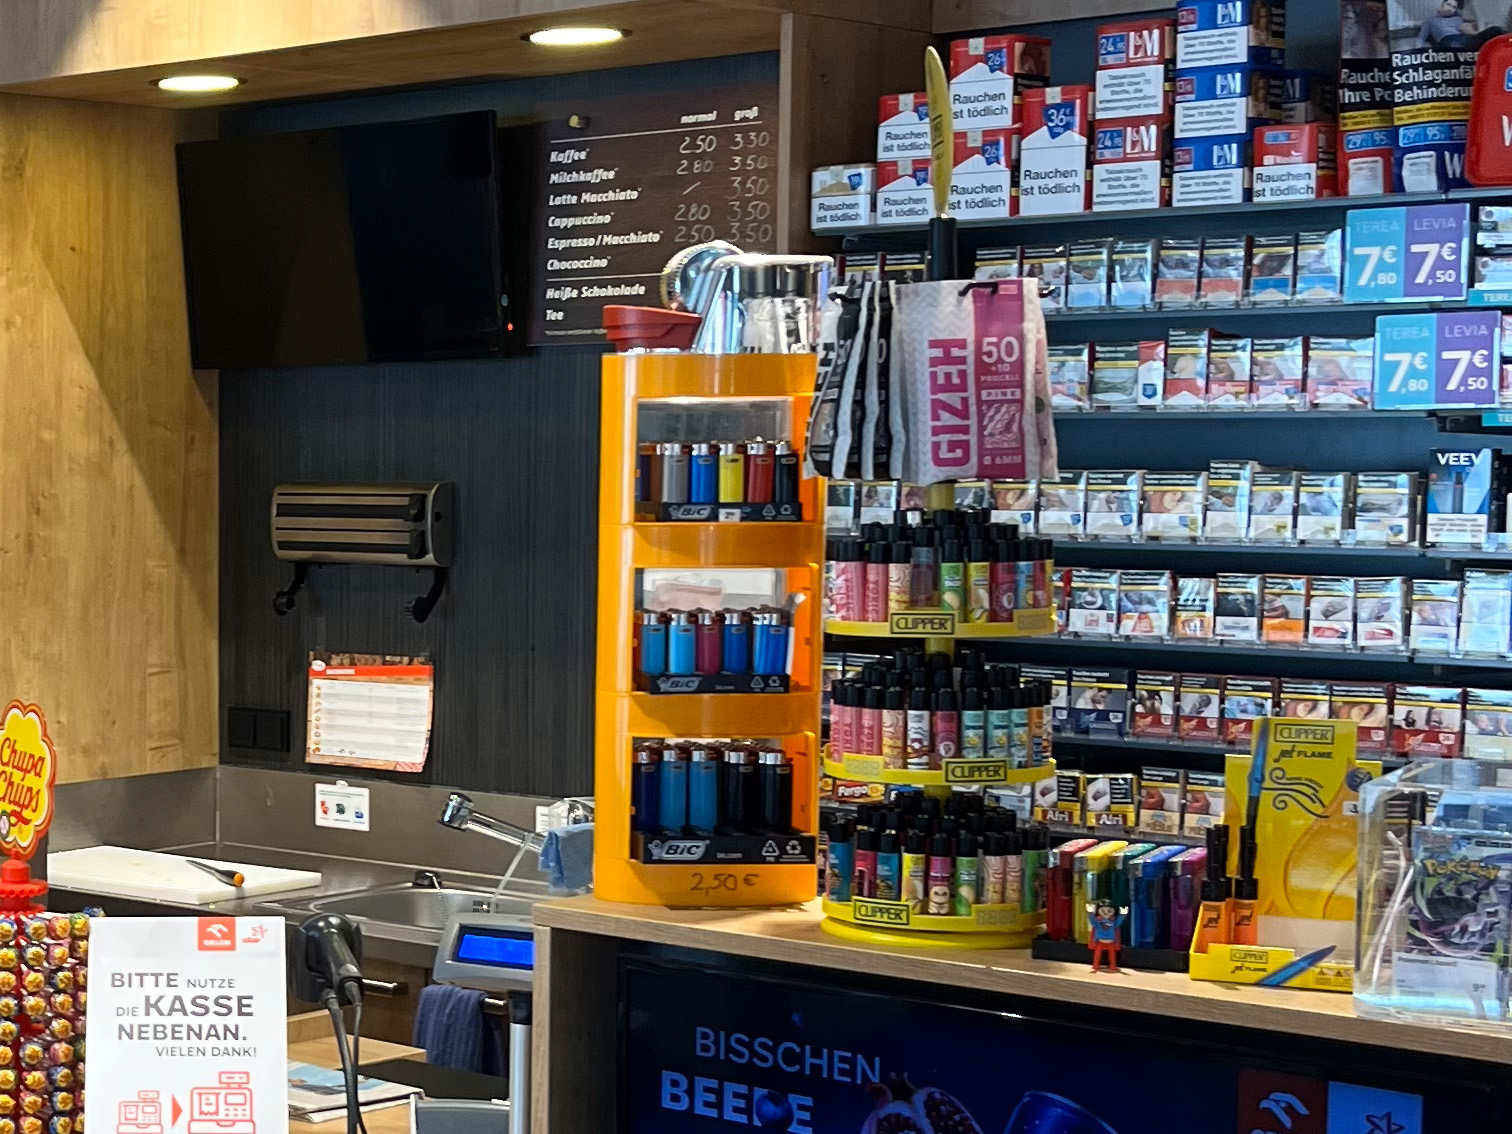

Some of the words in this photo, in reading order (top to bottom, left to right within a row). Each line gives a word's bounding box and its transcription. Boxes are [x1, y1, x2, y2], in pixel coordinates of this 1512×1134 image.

[1129, 29, 1160, 59] L&M
[1392, 50, 1455, 67] Rauchen
[1393, 66, 1475, 85] Schlaganfä
[1216, 73, 1241, 94] L&M
[953, 91, 1006, 105] Rauchen
[1394, 86, 1474, 103] Behinderu
[681, 111, 717, 124] normal
[963, 104, 1009, 118] tödlich
[1048, 108, 1066, 127] 36
[885, 130, 929, 142] Rauchen
[1126, 125, 1157, 153] L&M
[1023, 168, 1078, 181] Rauchen
[1256, 172, 1311, 183] Rauchen
[950, 183, 1003, 196] Rauchen
[1038, 182, 1081, 195] tödlich
[1270, 185, 1314, 197] tödlich
[549, 194, 578, 206] Latte
[884, 196, 927, 206] Rauchen
[964, 196, 1006, 209] tödlich
[1355, 220, 1400, 233] TEREA
[1414, 217, 1457, 231] LEVIA
[546, 288, 578, 301] Heiße
[581, 284, 646, 298] Schokolade
[545, 310, 564, 321] Tee
[1386, 327, 1429, 339] TEREA
[1445, 325, 1489, 337] LEVIA
[981, 336, 1019, 363] 50
[928, 338, 971, 468] GIZEH
[895, 617, 949, 630] CLIPPER
[1279, 727, 1331, 740] CLIPPER
[0, 737, 45, 782] Chupa
[1273, 745, 1296, 763] jet
[1297, 750, 1332, 759] FLAME
[951, 765, 1002, 779] CLIPPER
[1047, 809, 1072, 822] Afri
[1099, 812, 1123, 825] Afri
[690, 873, 737, 896] 2,50
[857, 904, 904, 921] CLIPPER
[1231, 950, 1267, 962] CLIPPER
[110, 972, 179, 988] BITTE
[186, 978, 235, 988] NUTZE
[116, 1006, 139, 1017] DIE
[144, 995, 254, 1017] KASSE
[117, 1023, 247, 1041] NEBENAN.
[155, 1046, 207, 1057] VIELEN
[211, 1046, 257, 1058] DANK!
[695, 1026, 880, 1084] BISSCHEN
